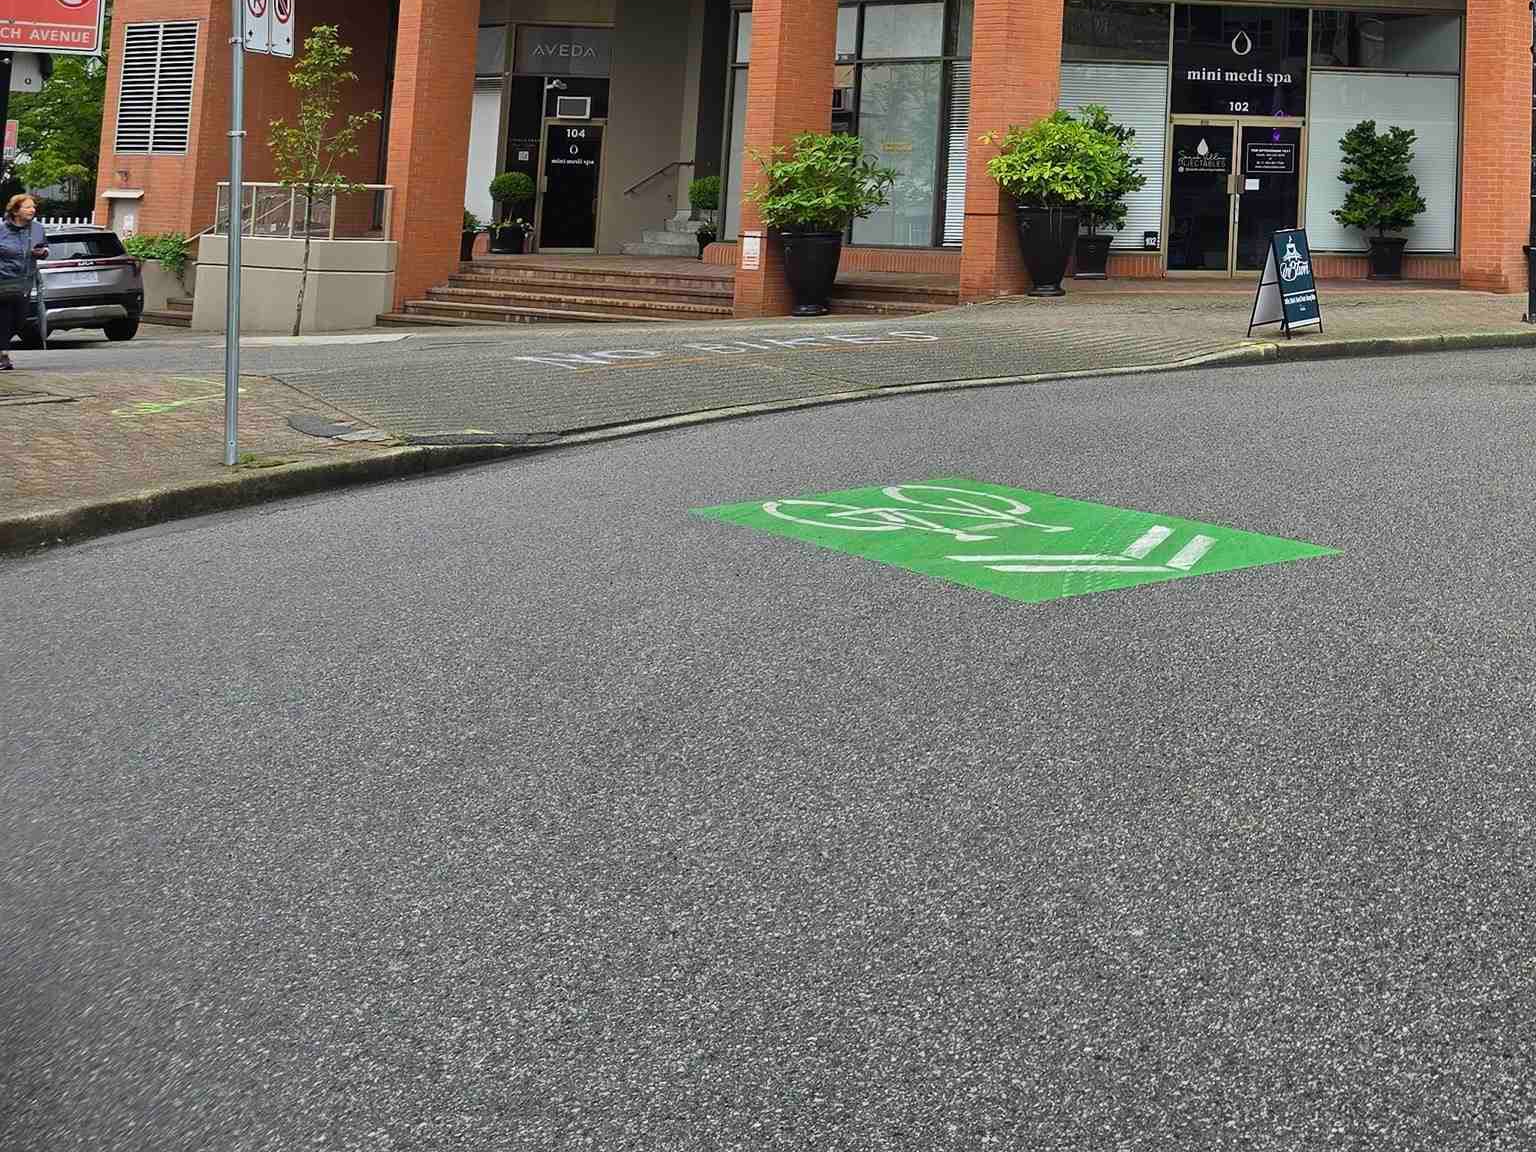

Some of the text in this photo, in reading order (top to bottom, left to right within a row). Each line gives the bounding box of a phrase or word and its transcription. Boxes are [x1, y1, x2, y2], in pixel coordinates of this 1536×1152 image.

[29, 29, 91, 44] AVENUE
[532, 44, 597, 57] AVEDA
[1187, 67, 1292, 87] mini medi spa
[1229, 101, 1249, 112] 102
[566, 128, 586, 138] 104
[583, 159, 595, 167] spa
[513, 330, 940, 369] NO BIKES
